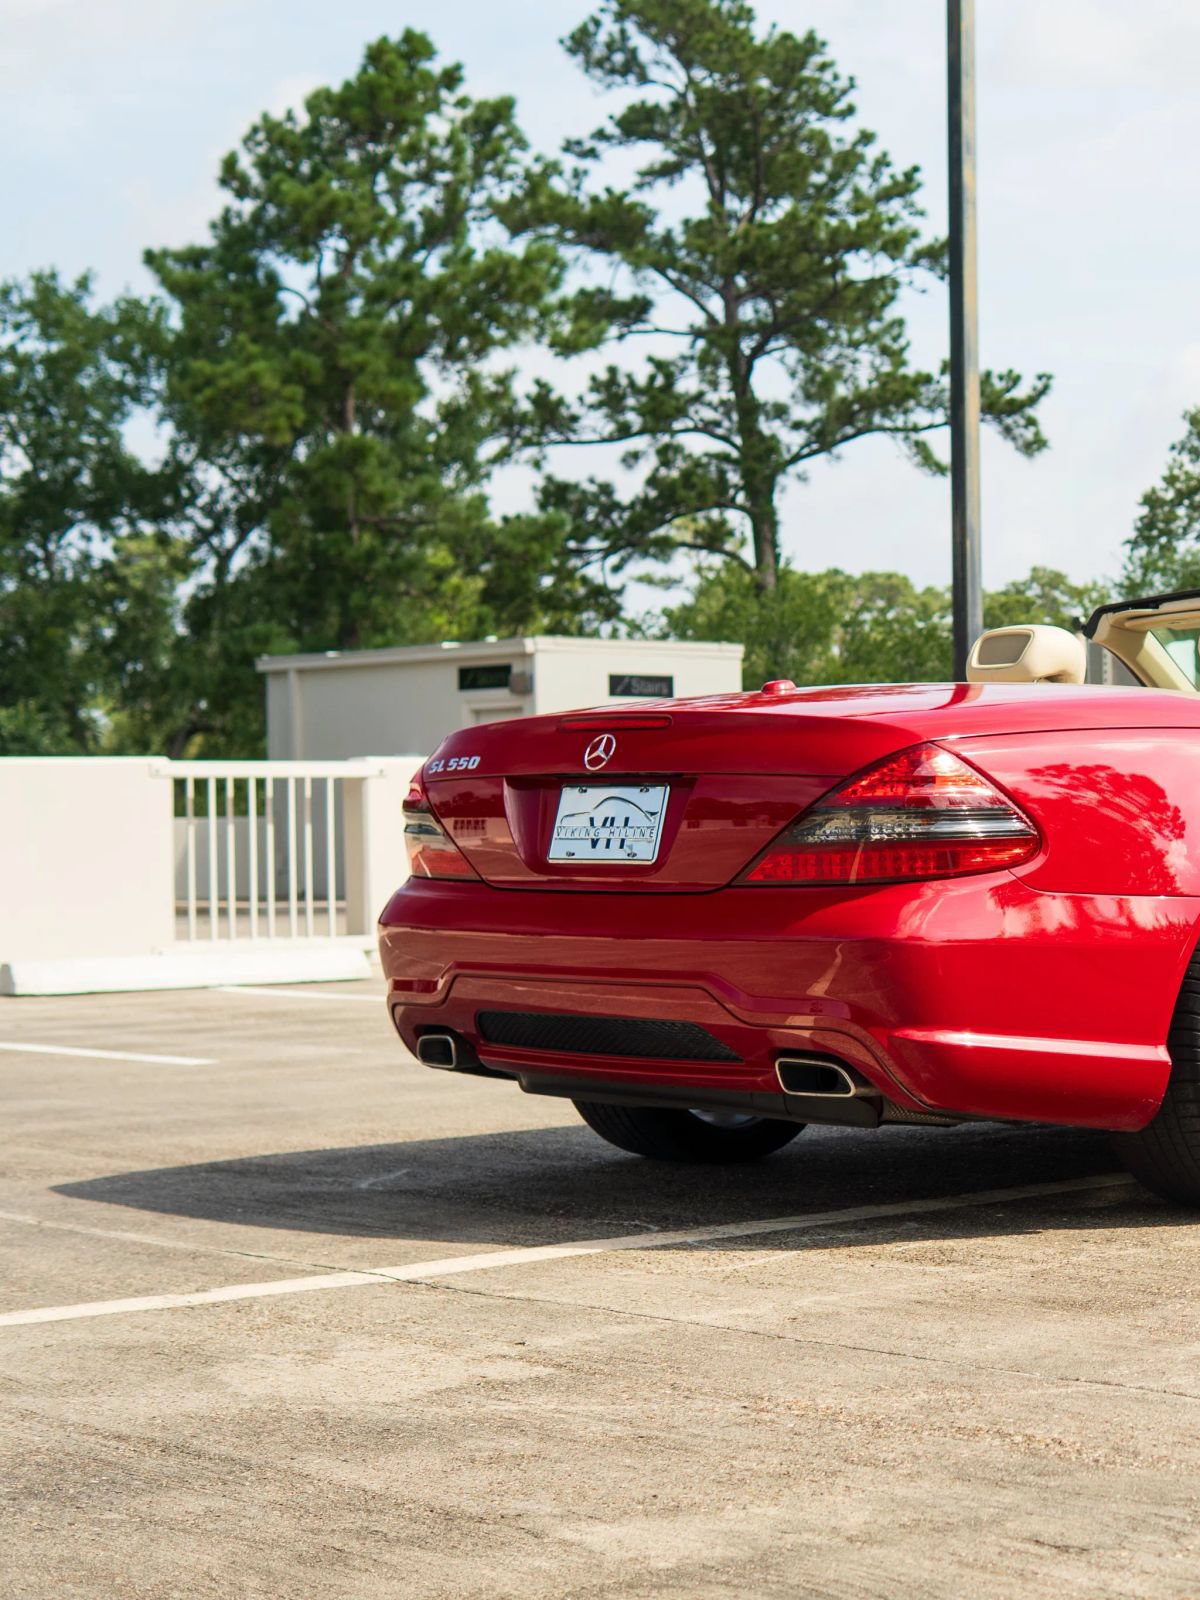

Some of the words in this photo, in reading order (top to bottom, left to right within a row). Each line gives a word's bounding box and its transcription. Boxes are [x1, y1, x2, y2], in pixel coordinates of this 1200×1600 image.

[428, 759, 445, 774] SL
[446, 756, 481, 771] 550
[556, 827, 601, 838] VIKING
[608, 827, 655, 838] HILINE
